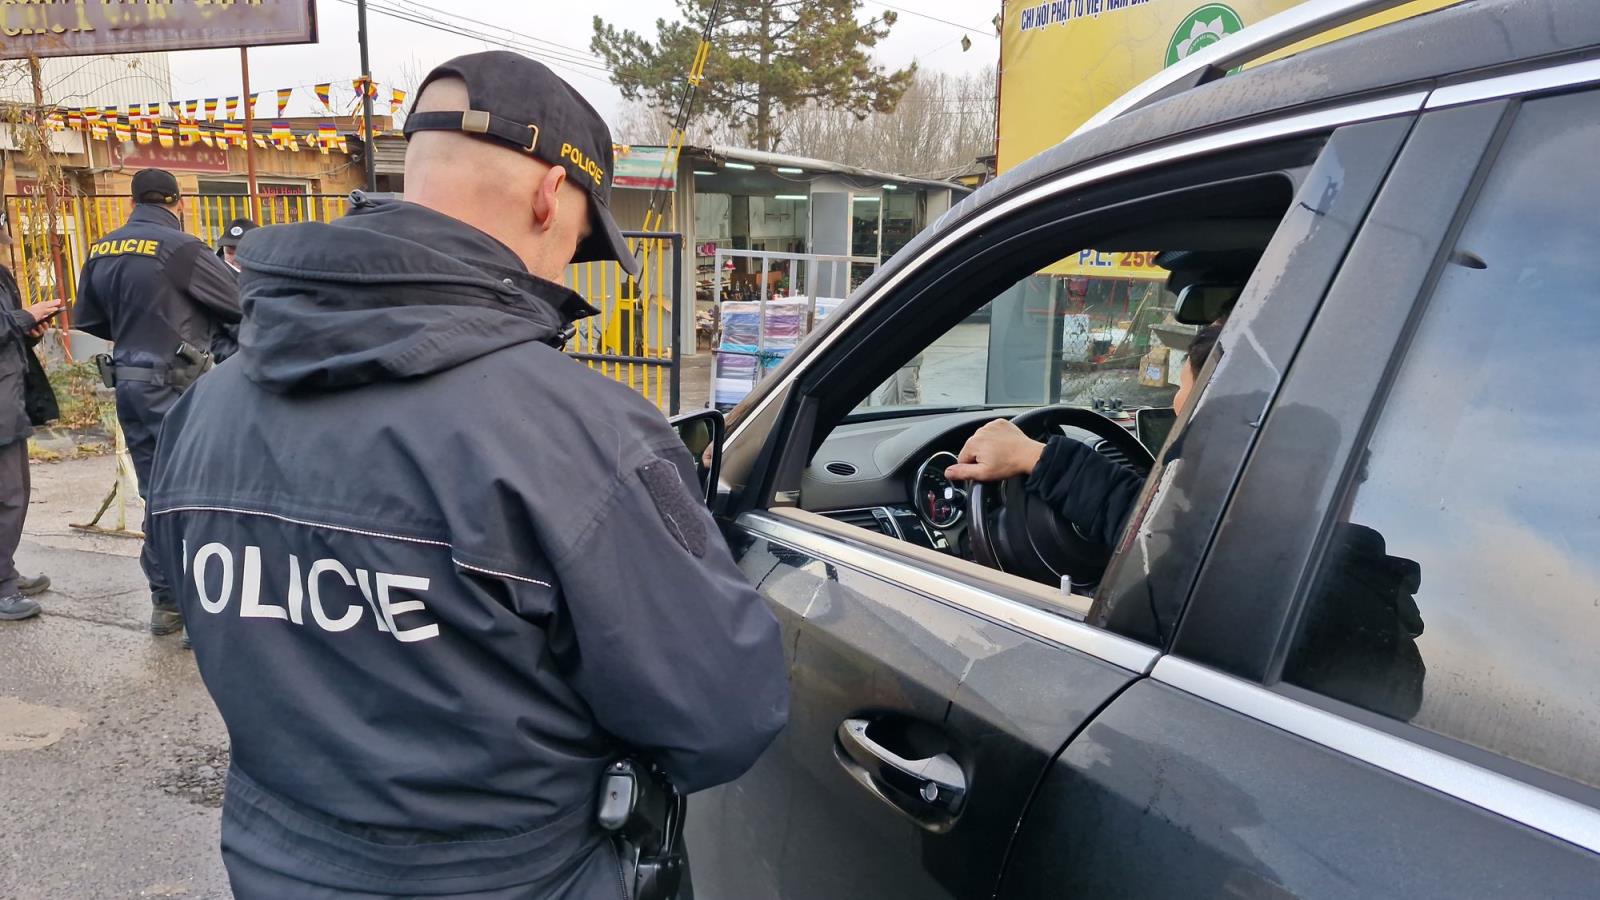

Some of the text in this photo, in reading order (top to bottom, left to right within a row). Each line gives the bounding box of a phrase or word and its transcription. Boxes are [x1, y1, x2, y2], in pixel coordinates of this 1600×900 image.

[1021, 9, 1035, 30] CHI
[561, 142, 604, 186] POLICIE
[89, 239, 159, 259] POLICIE
[1079, 249, 1112, 267] P.L:
[182, 538, 440, 643] OLICIE
